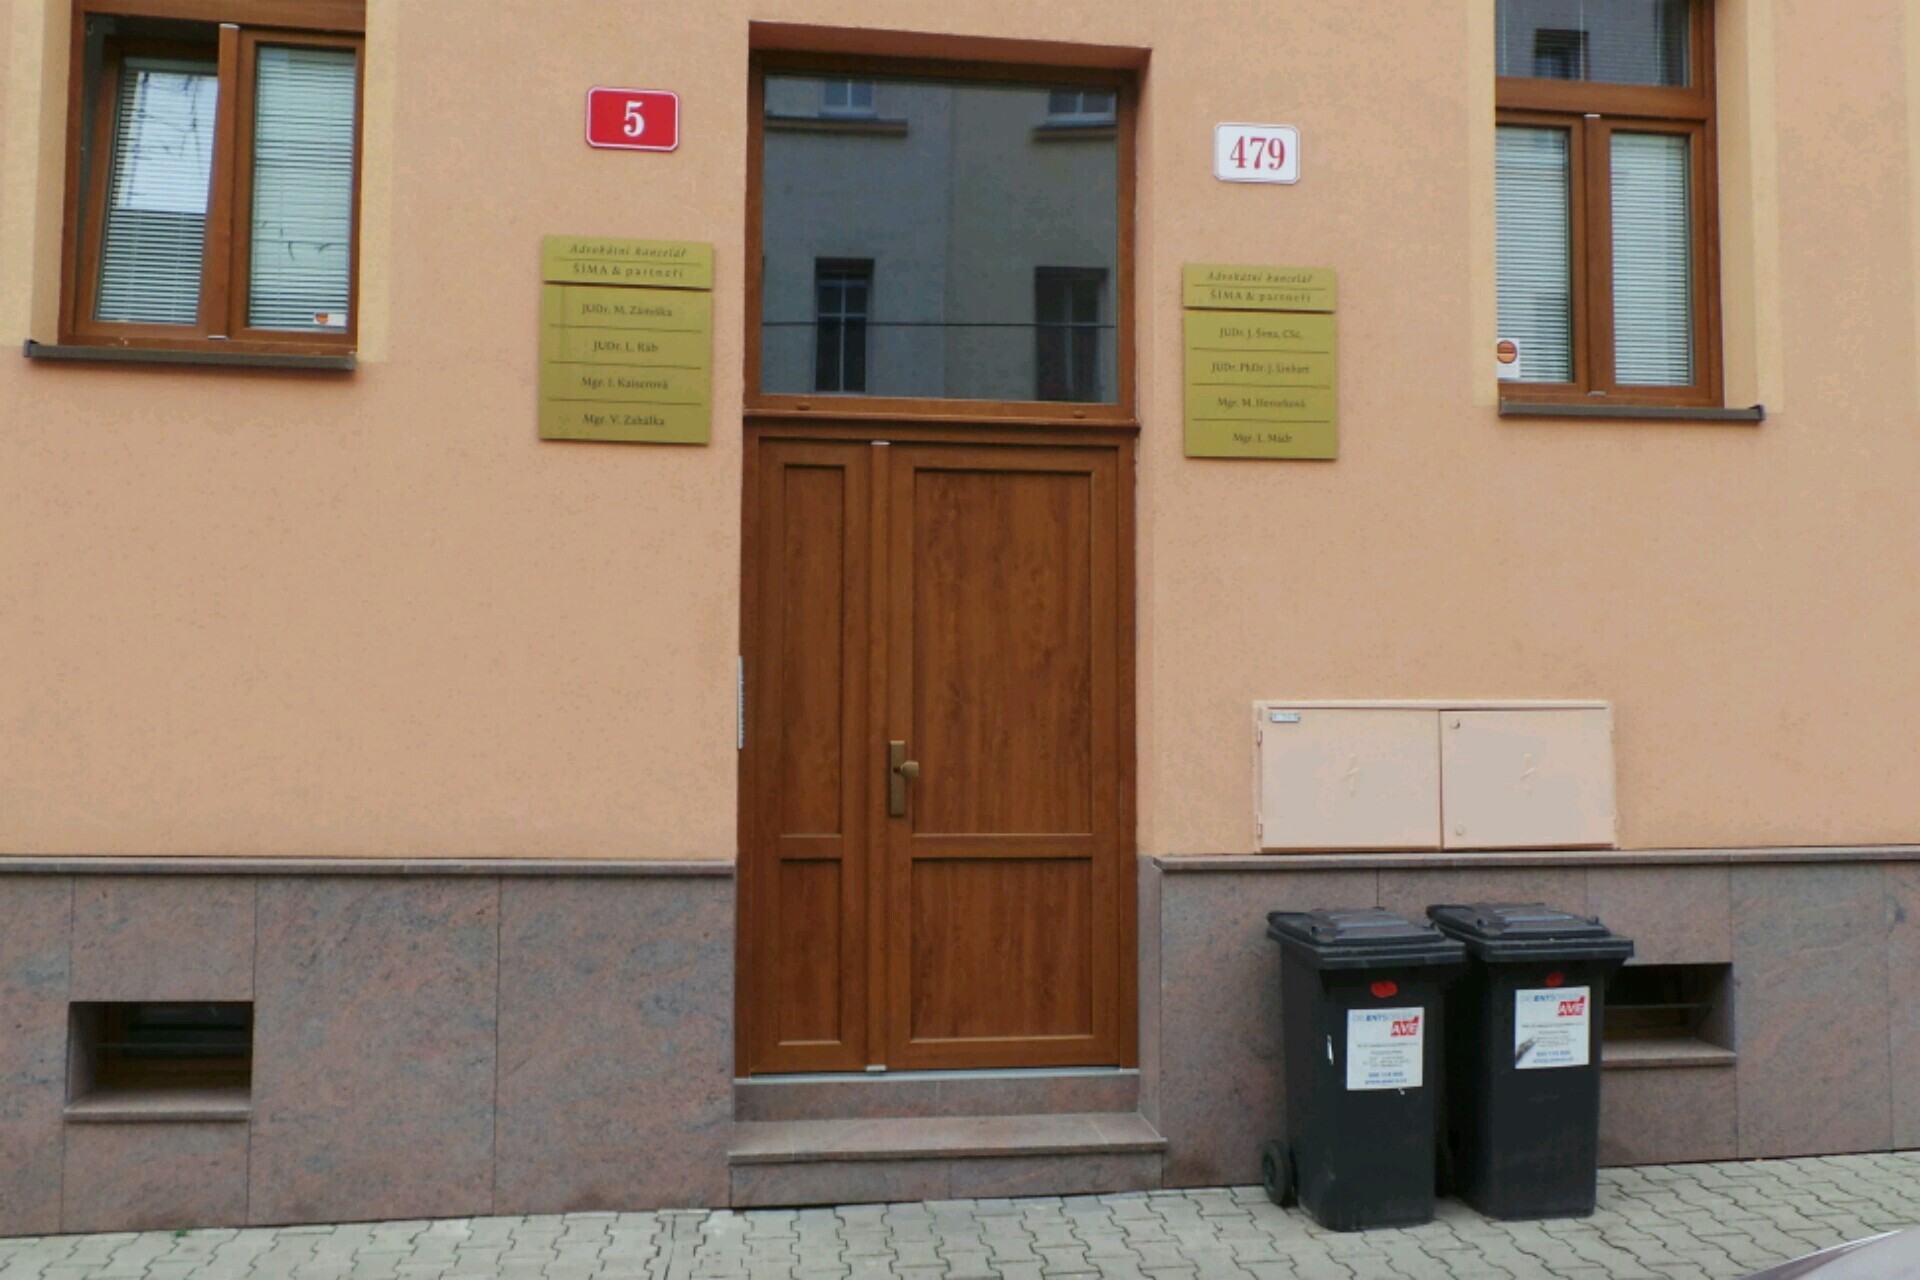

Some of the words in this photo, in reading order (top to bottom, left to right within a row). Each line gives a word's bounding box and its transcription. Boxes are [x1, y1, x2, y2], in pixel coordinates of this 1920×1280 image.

[623, 100, 645, 137] 5
[1229, 135, 1286, 171] 479
[612, 266, 622, 276] &
[1246, 291, 1255, 301] &
[1391, 1020, 1418, 1036] AVE
